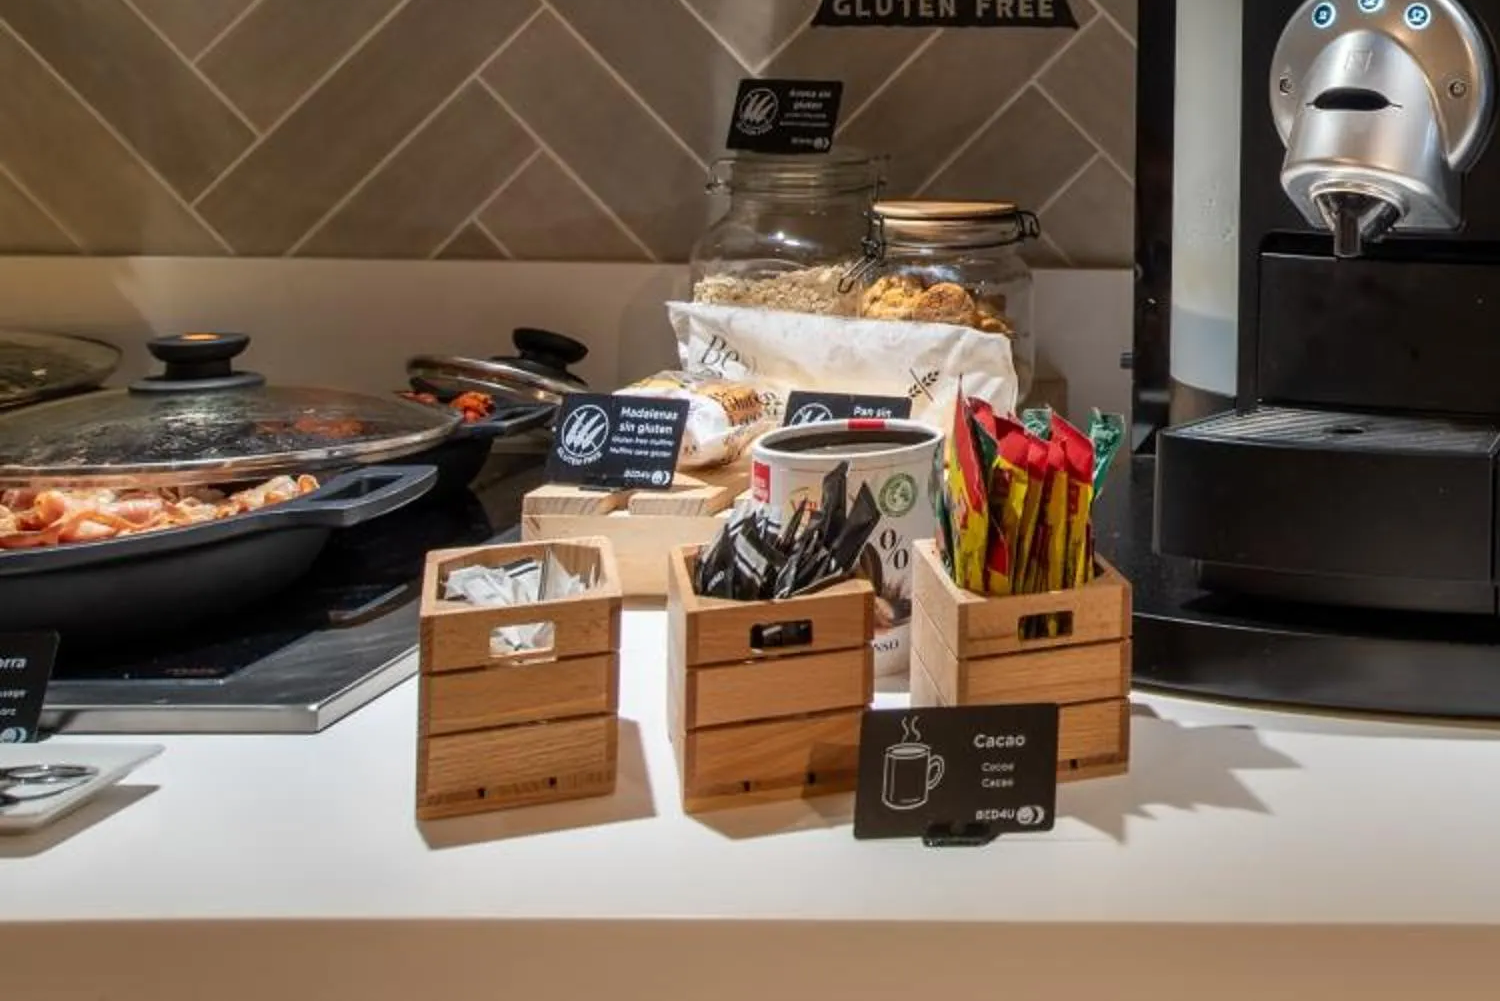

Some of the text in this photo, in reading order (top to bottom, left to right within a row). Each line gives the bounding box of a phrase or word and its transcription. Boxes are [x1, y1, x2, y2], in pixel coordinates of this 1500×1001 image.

[637, 424, 673, 435] gluten
[973, 734, 1026, 748] Cacao
[975, 809, 1015, 821] BED4U
